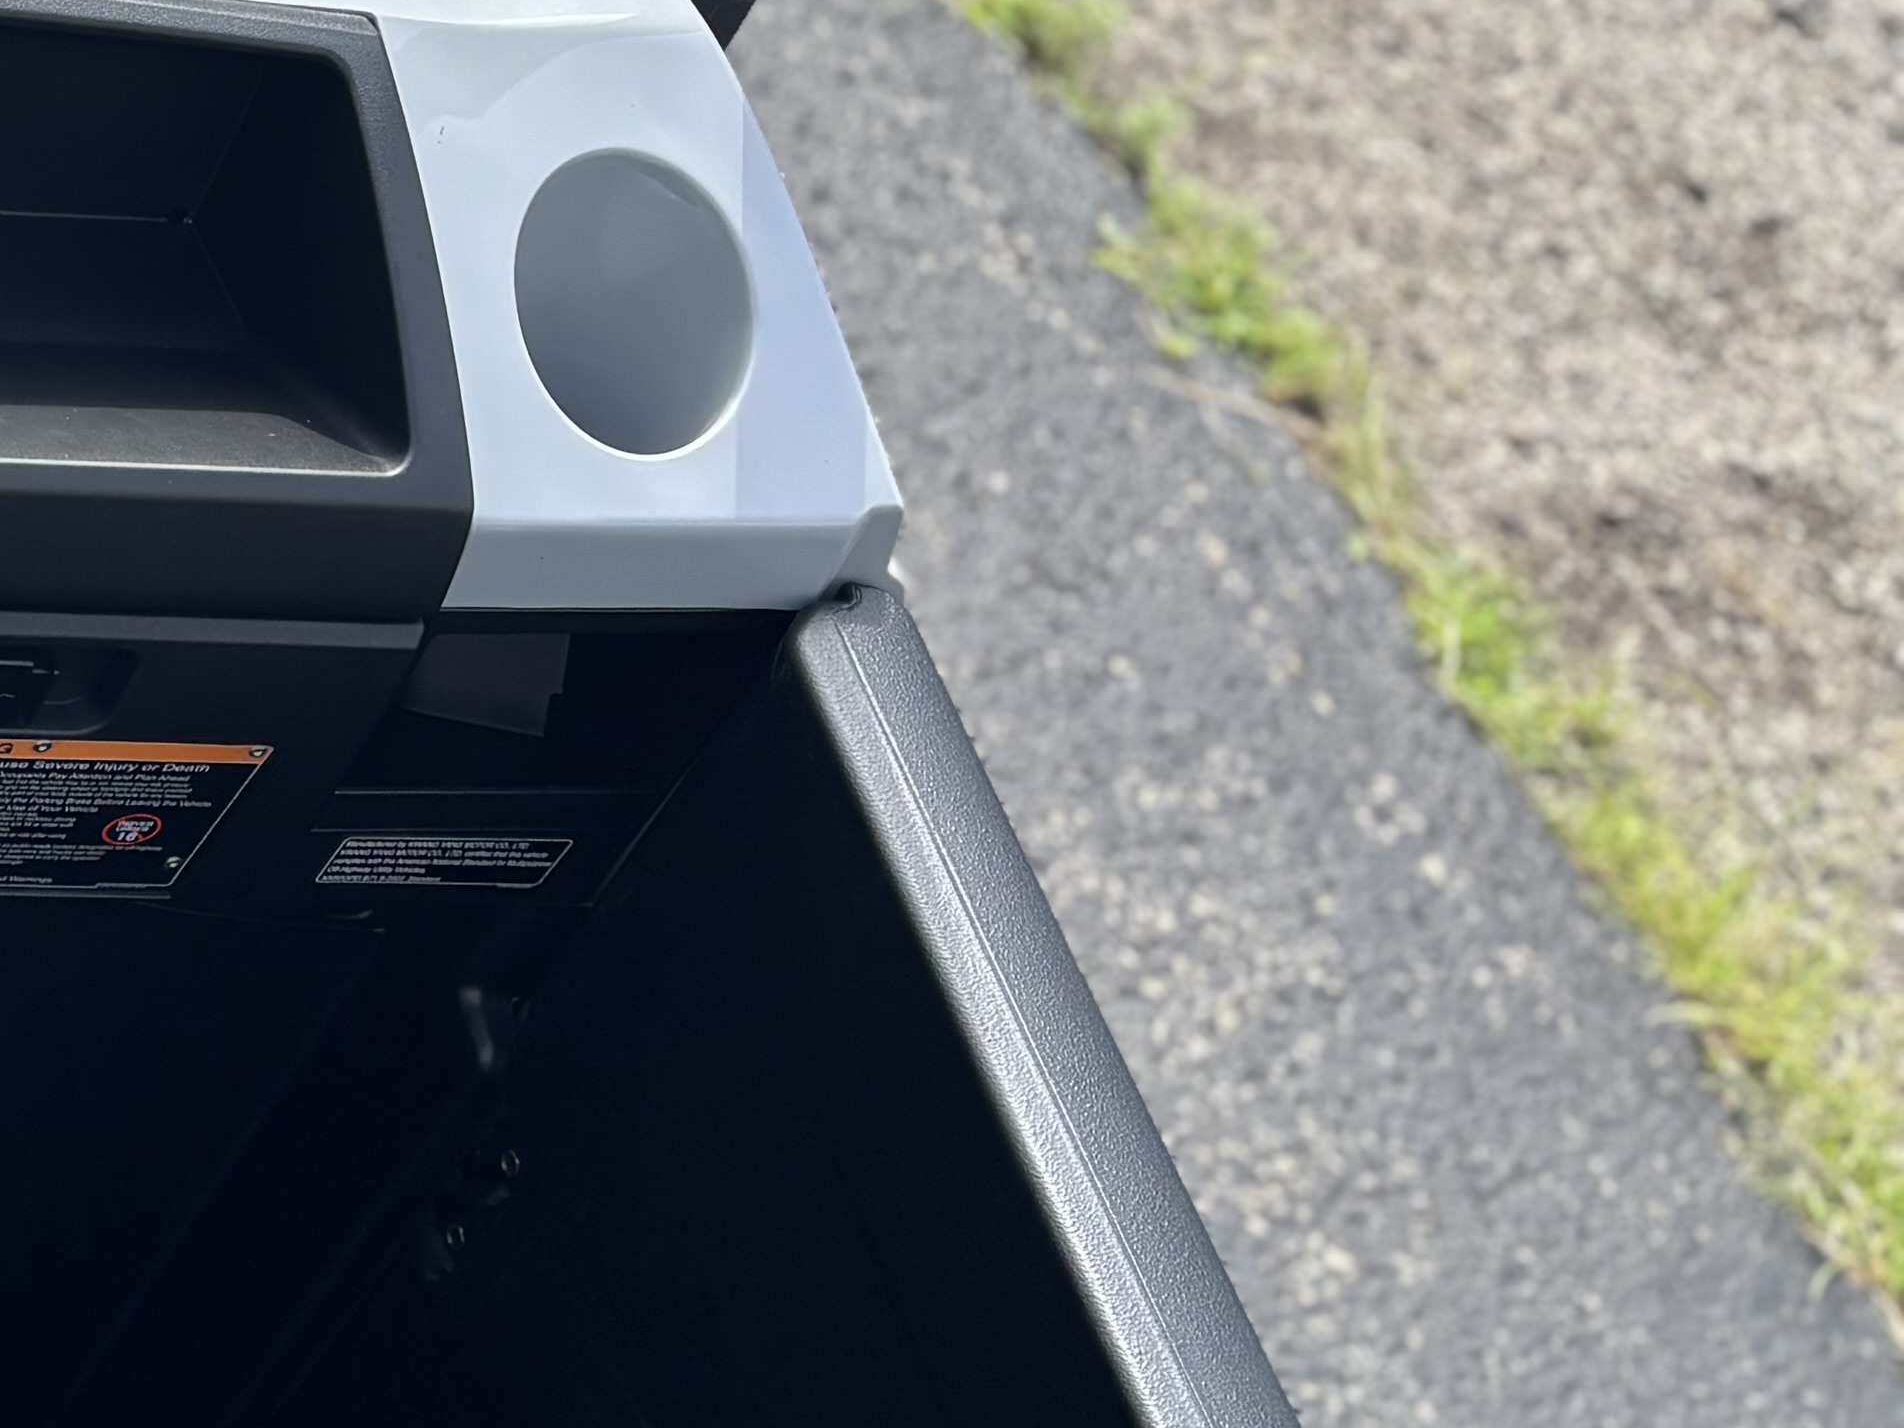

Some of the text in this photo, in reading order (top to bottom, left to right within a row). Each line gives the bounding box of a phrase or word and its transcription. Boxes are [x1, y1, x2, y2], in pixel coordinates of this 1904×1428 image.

[33, 760, 90, 771] Severe
[94, 761, 139, 773] Injury
[141, 763, 159, 772] or
[162, 763, 211, 773] Death
